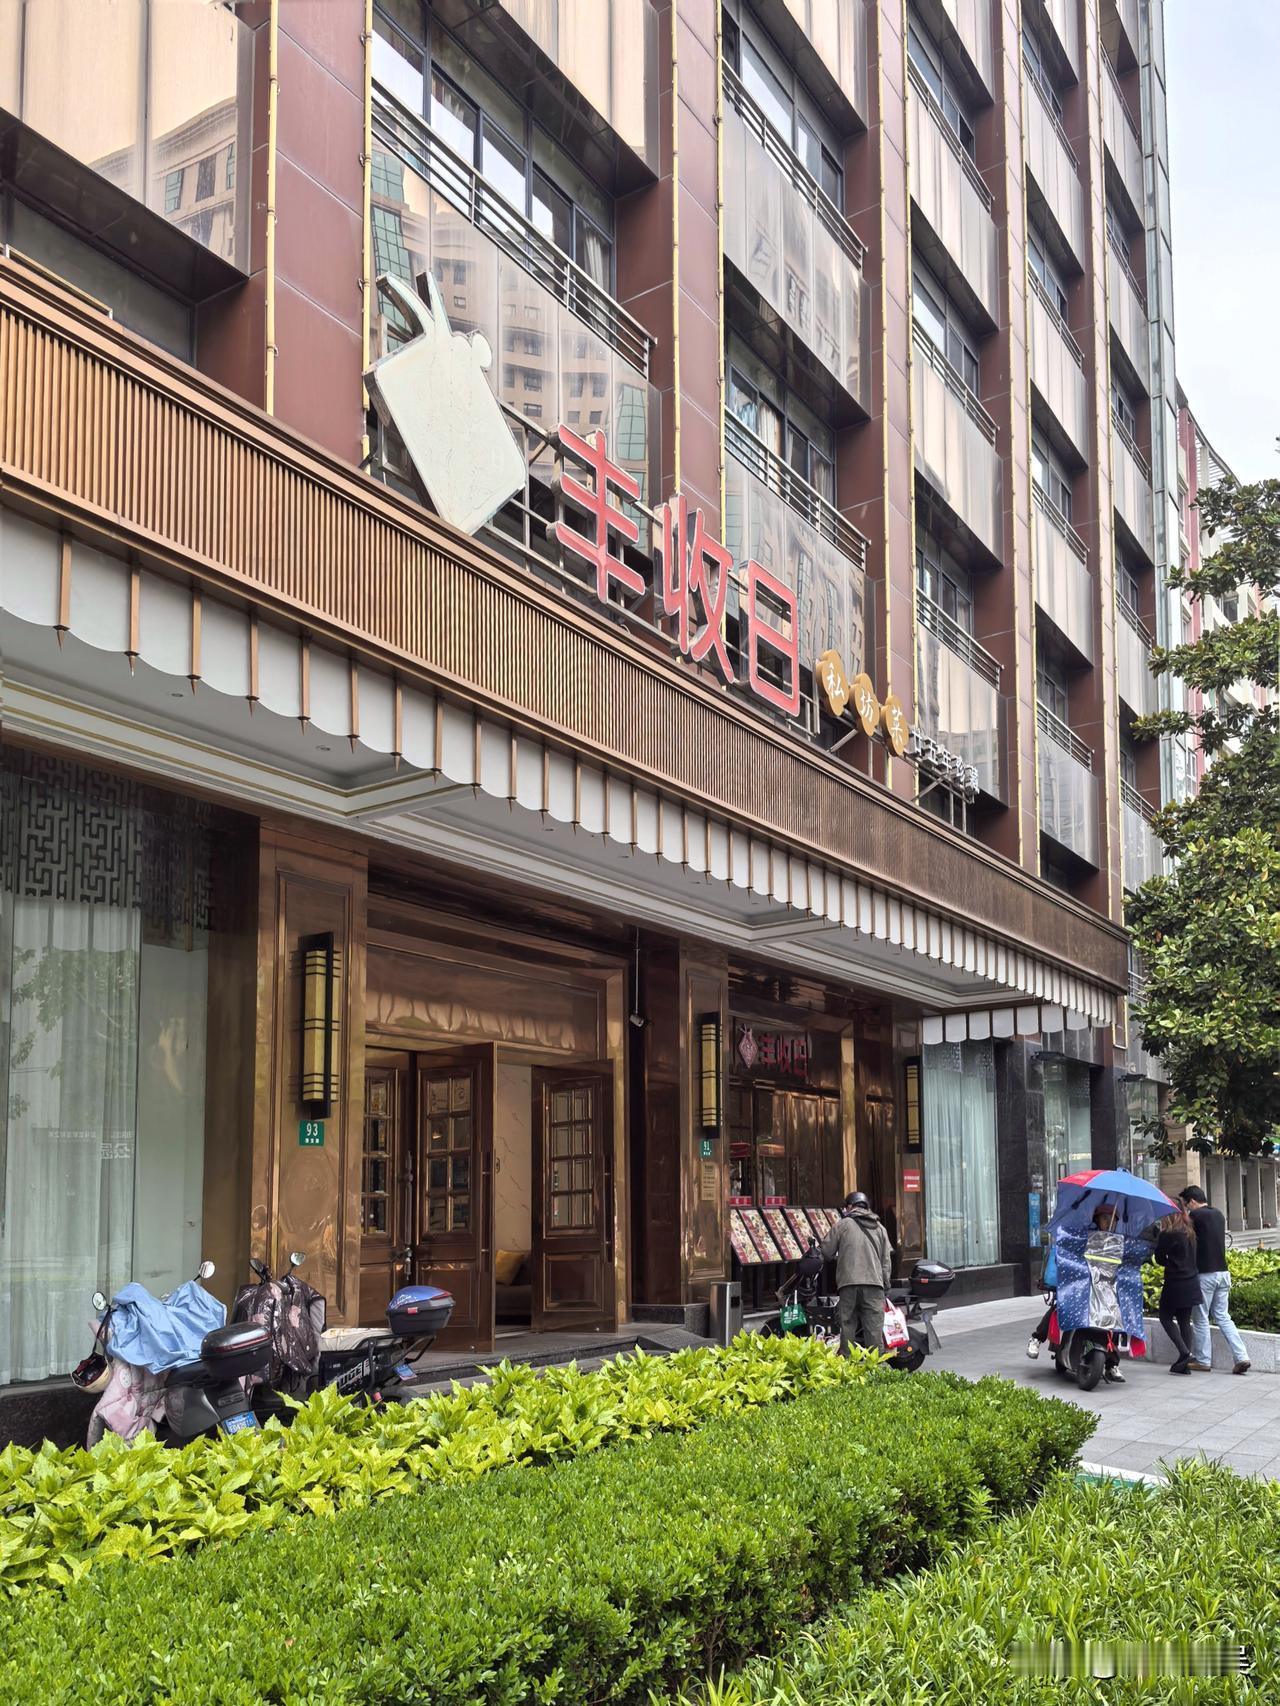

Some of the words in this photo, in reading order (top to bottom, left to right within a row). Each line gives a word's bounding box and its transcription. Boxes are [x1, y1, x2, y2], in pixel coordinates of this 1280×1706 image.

[553, 423, 800, 718] 丰收日
[825, 661, 904, 747] 私坊菜
[306, 1122, 319, 1137] 93
